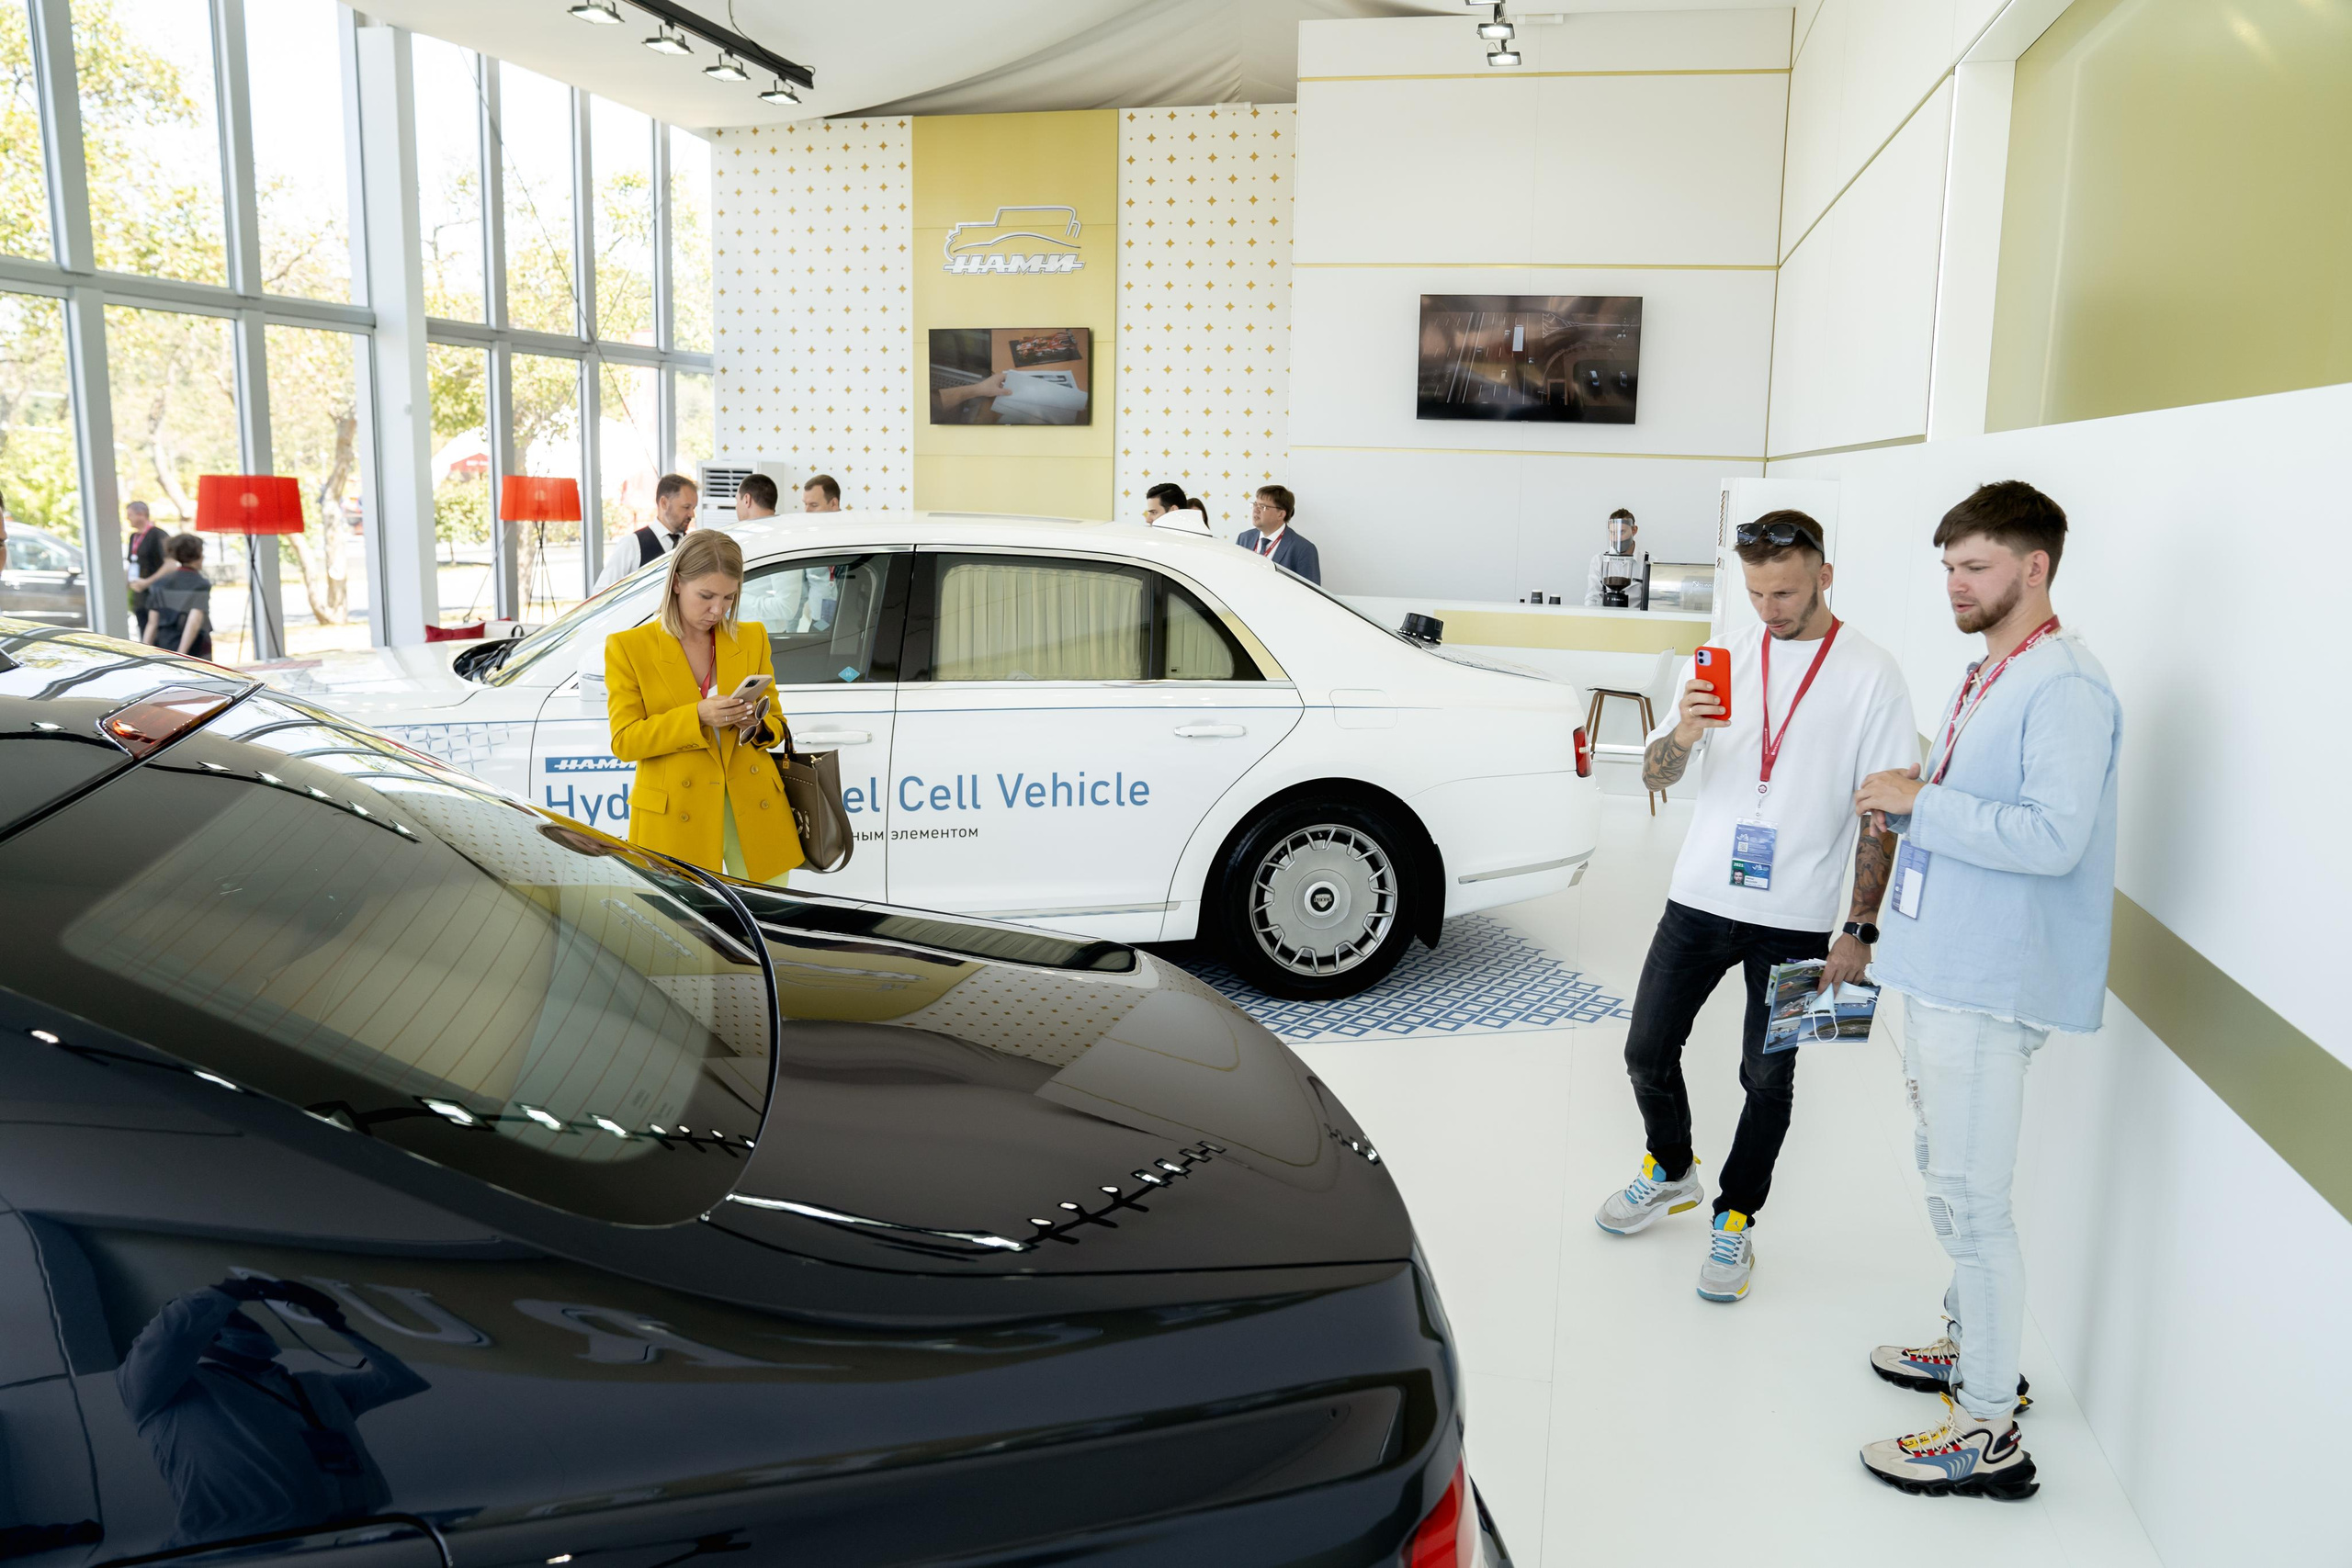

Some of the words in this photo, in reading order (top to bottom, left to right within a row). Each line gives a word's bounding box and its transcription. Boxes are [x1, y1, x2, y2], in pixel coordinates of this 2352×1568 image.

[944, 254, 1084, 275] НАМИ
[899, 774, 980, 811] Cell
[996, 771, 1150, 809] Vehicle
[890, 828, 978, 840] элементом
